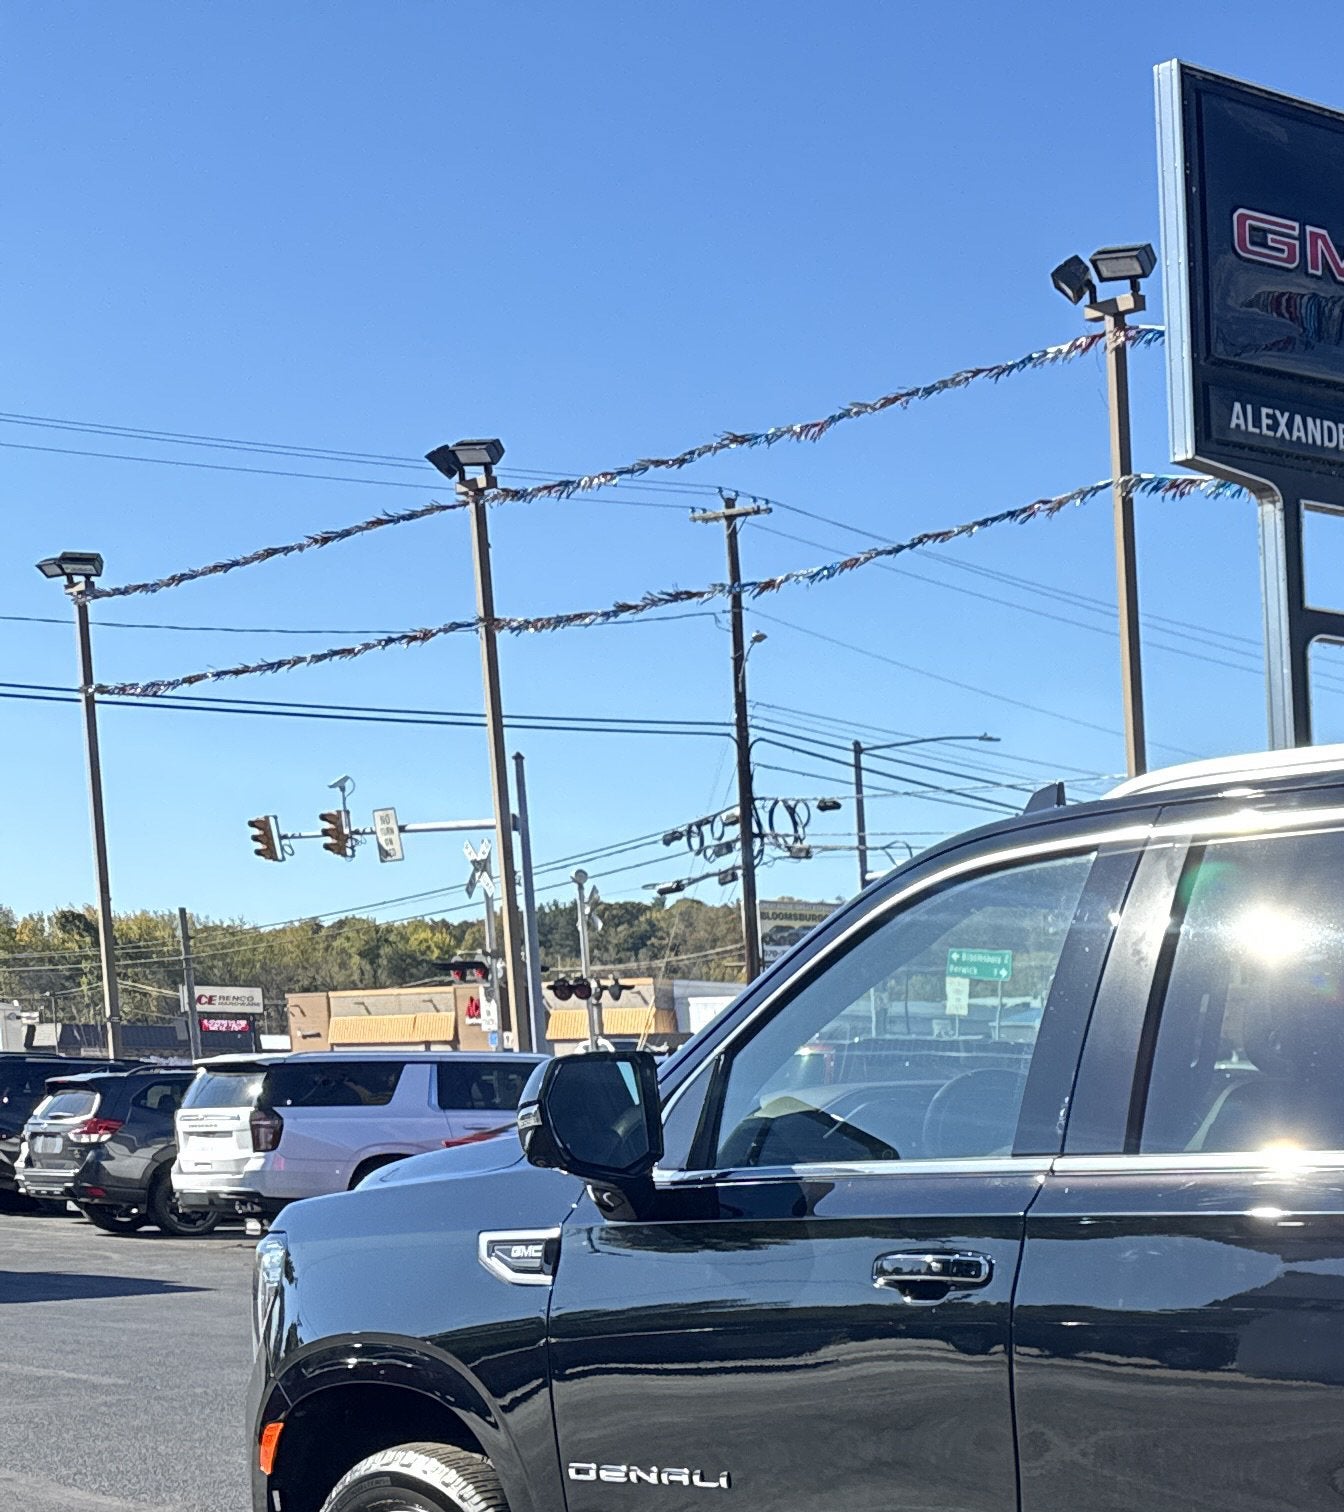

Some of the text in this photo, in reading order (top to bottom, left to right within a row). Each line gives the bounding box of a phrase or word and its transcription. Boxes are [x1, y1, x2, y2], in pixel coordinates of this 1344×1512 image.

[380, 814, 391, 825] NO
[196, 994, 217, 1006] CE
[511, 1245, 543, 1257] GMC
[568, 1463, 731, 1489] DENALI
